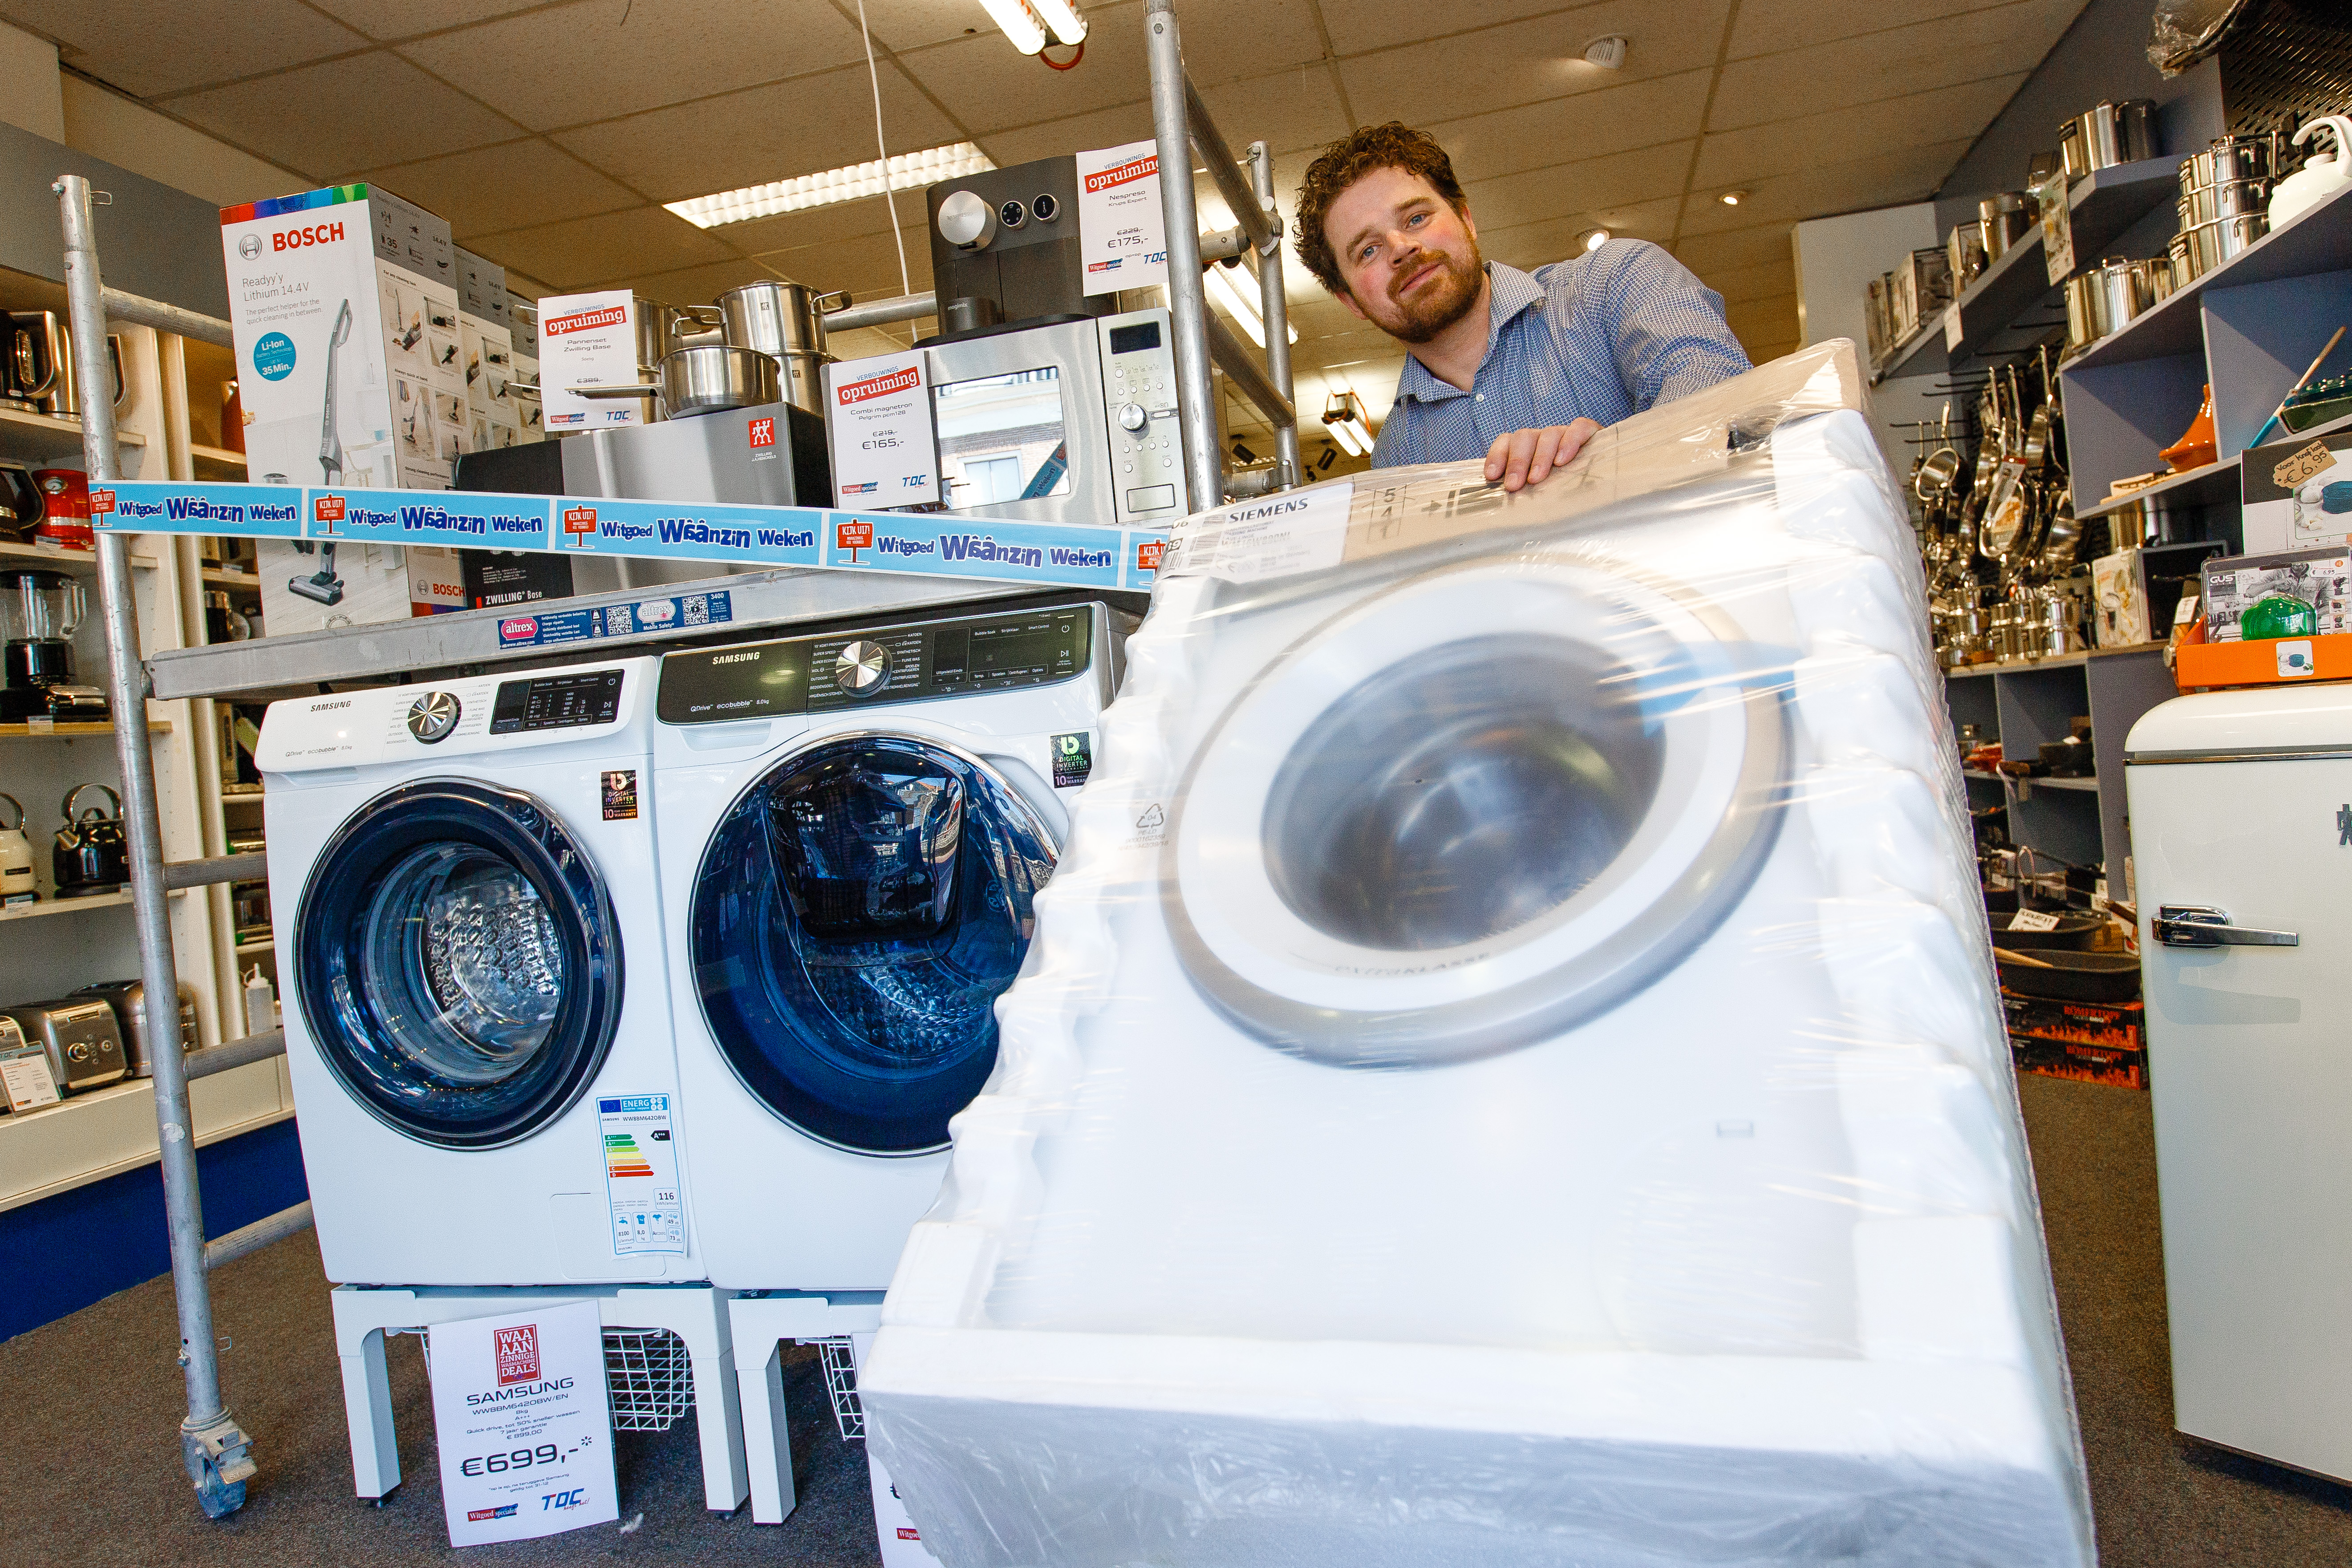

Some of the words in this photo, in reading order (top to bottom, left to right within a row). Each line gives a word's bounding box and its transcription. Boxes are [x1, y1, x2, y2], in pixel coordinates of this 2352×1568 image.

[1104, 153, 1145, 169] VERBOUWINGS
[1109, 190, 1145, 200] Nespreso
[272, 222, 345, 252] BOSCH
[387, 237, 397, 249] 35
[1107, 236, 1148, 248] €175,-
[243, 272, 284, 288] Readyy'y
[244, 288, 279, 302] Lithium
[258, 306, 279, 314] perfect
[280, 302, 299, 311] helper
[564, 304, 604, 315] VERBOUWINGS
[247, 316, 262, 325] quick
[264, 312, 288, 321] cleaning
[548, 310, 624, 333] opruiming
[261, 340, 284, 351] Li-Ion
[262, 365, 273, 375] 35
[856, 366, 899, 381] VERBOUWINGS
[841, 371, 918, 402] opruiming
[875, 403, 912, 413] magnetron
[883, 410, 906, 419] pcm128
[862, 438, 904, 450] €165,-
[2276, 460, 2294, 470] Voor
[92, 494, 103, 502] KIJK
[320, 500, 332, 509] KIJK
[119, 502, 162, 518] Witgoed
[249, 505, 296, 520] Weken
[568, 511, 582, 521] KIJK
[1229, 498, 1308, 524] SIEMENS
[349, 509, 397, 527] Witgoed
[491, 515, 543, 532] Weken
[601, 522, 653, 540] Witgoed
[758, 530, 814, 547] Weken
[842, 526, 856, 535] KIJK
[878, 537, 934, 556] Witgoed
[1050, 548, 1111, 567] Weken
[1144, 546, 1160, 556] KIJK
[433, 583, 466, 596] BOSCH
[527, 590, 542, 600] Base
[642, 604, 671, 616] altrex
[506, 621, 533, 634] altrex
[713, 652, 760, 664] SAMSUNG
[311, 701, 351, 712] SAMSUNG
[1056, 760, 1087, 768] INVERTER
[1055, 775, 1067, 786] 10
[604, 809, 614, 818] 10
[623, 1099, 649, 1107] ENERG
[658, 1192, 674, 1200] 116
[499, 1329, 533, 1344] WAA
[500, 1339, 533, 1356] AAN
[500, 1351, 535, 1363] ZINNIGE
[501, 1358, 536, 1368] WASMACHINE
[502, 1363, 536, 1377] DEALS
[467, 1377, 574, 1406] SAMSUNG
[556, 1410, 580, 1418] wassen
[520, 1422, 547, 1432] garantie
[514, 1429, 542, 1438] 899,00
[542, 1488, 584, 1511] TOC
[469, 1510, 494, 1519] Witgoed
